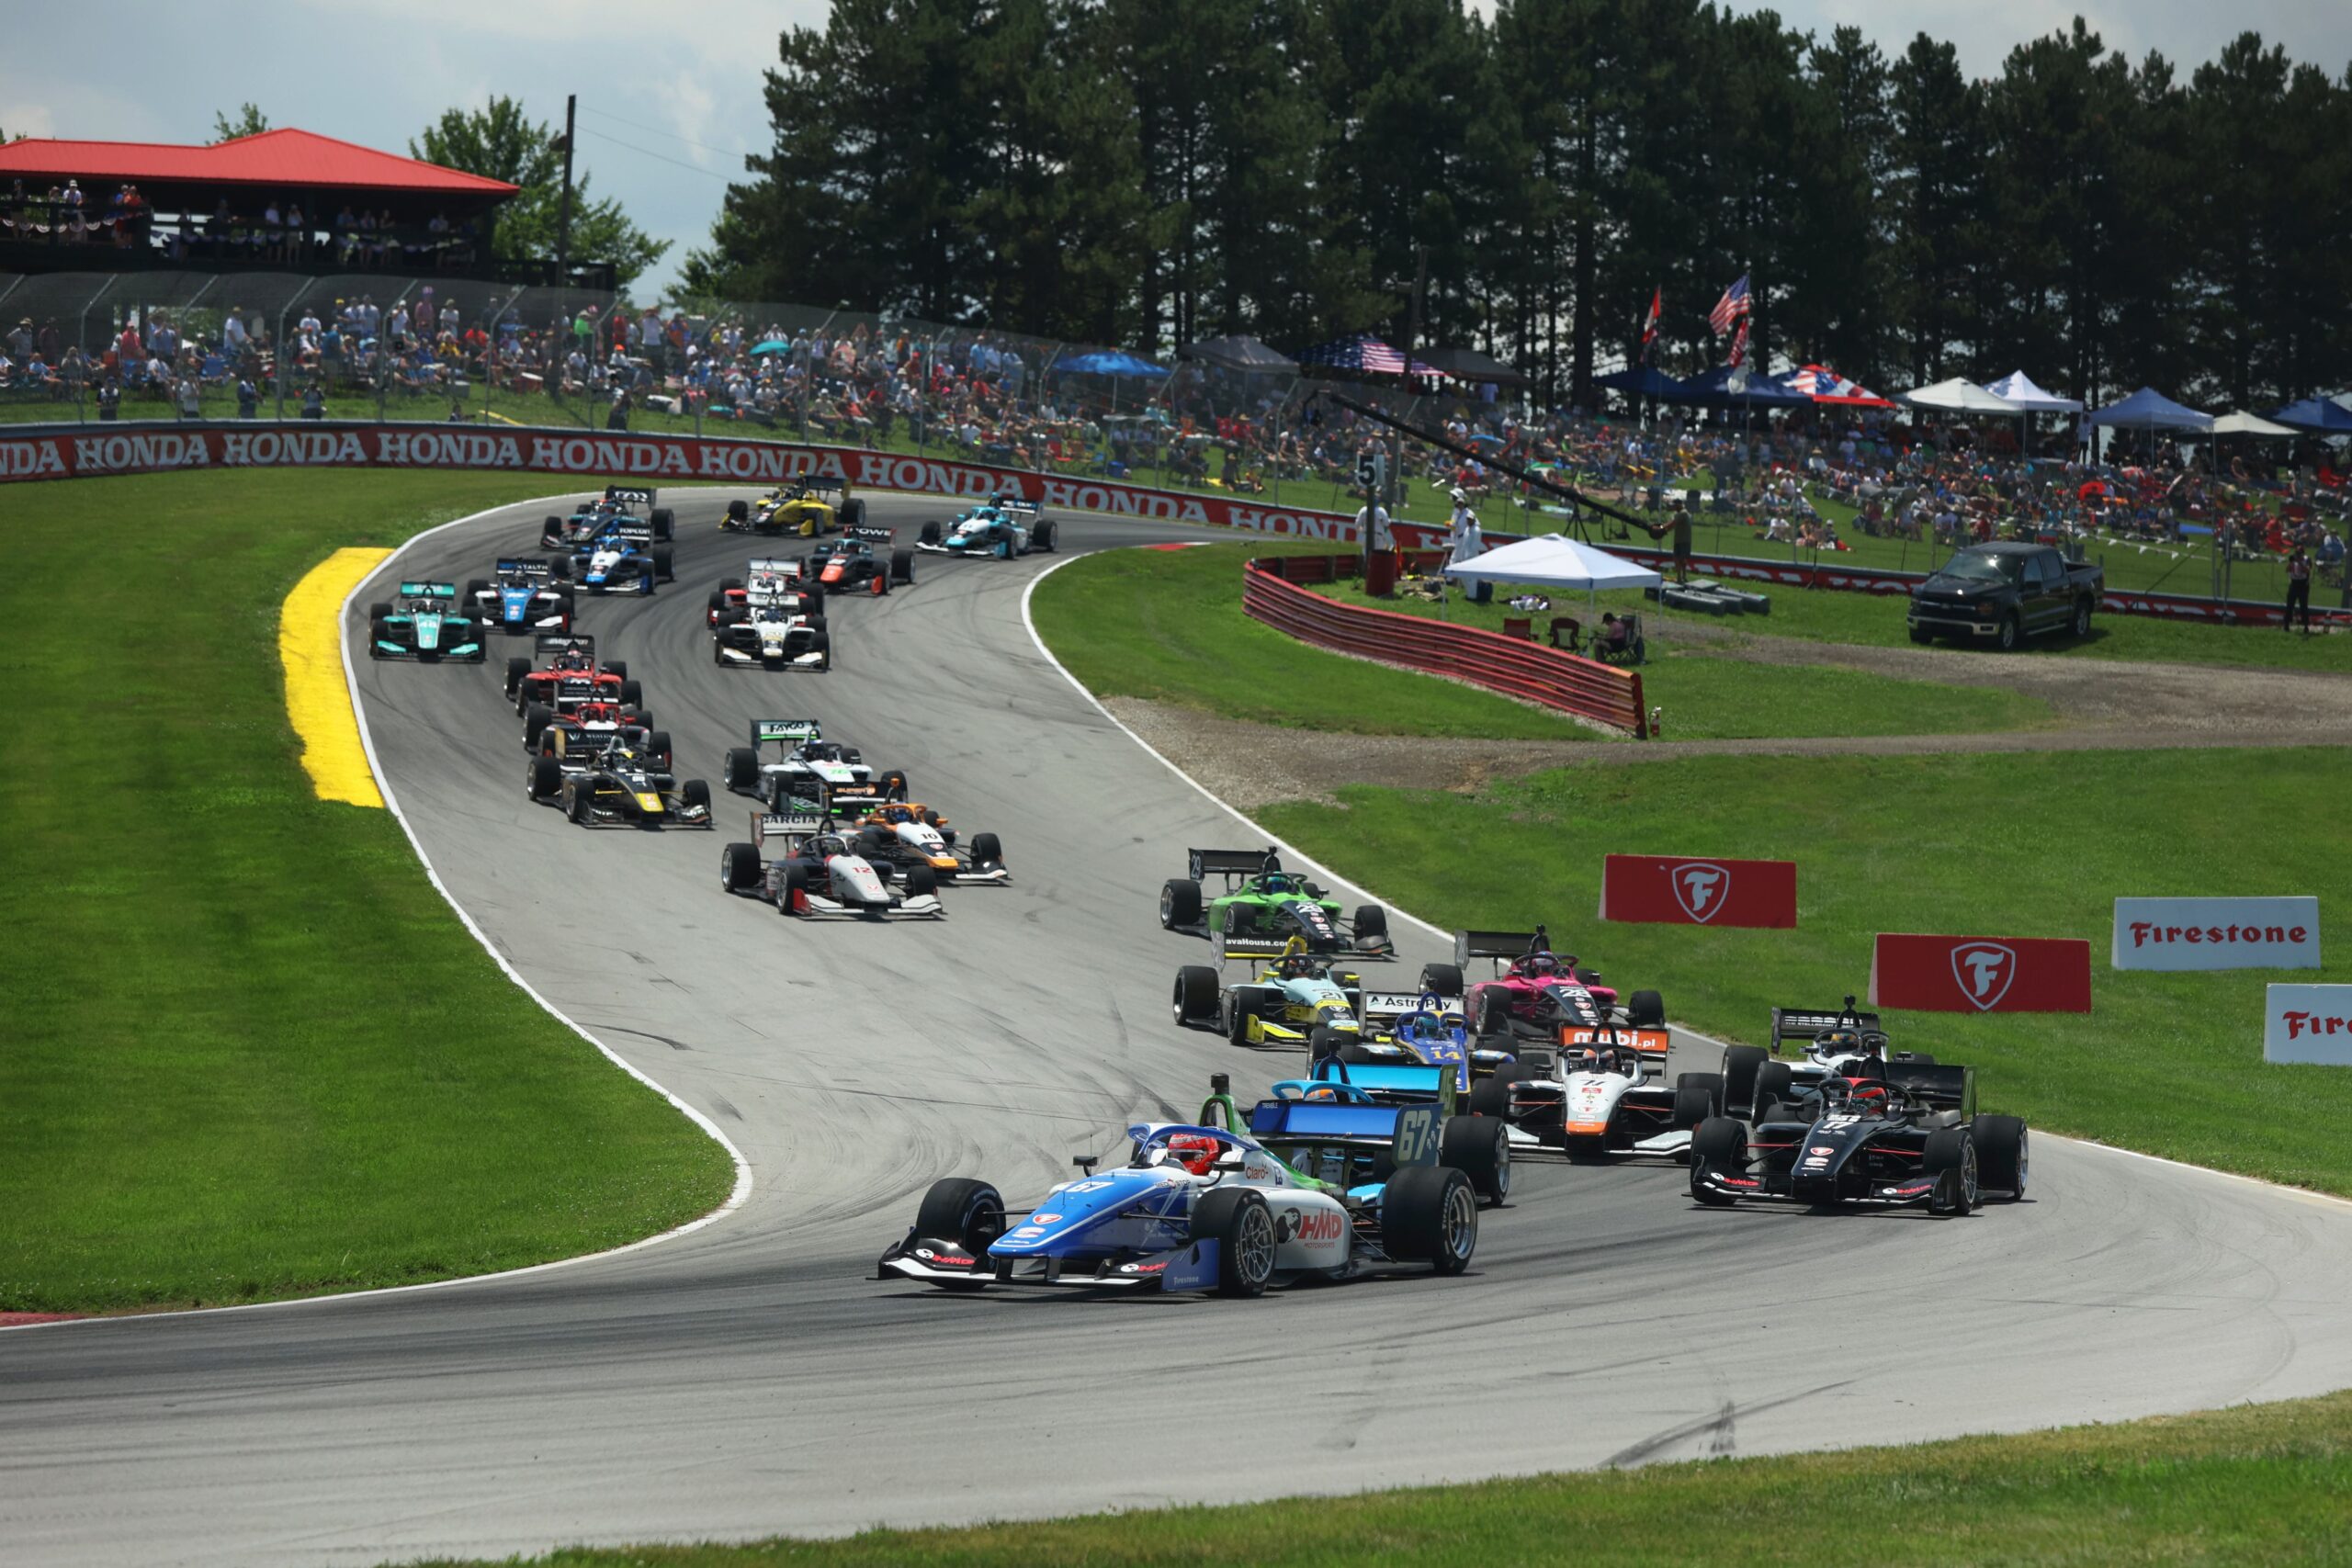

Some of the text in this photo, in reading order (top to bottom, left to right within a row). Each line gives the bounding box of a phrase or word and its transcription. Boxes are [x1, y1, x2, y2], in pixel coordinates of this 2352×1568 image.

[74, 434, 209, 470] HONDA
[222, 432, 366, 466] HONDA
[376, 432, 524, 466] HONDA
[528, 437, 693, 474] HONDA
[698, 446, 852, 479] HONDA
[855, 455, 1024, 499] HONDA
[1358, 455, 1375, 484] 5
[1042, 480, 1209, 523] HONDA
[763, 816, 817, 824] GARCIA
[2129, 921, 2308, 948] Firestone
[1385, 997, 1452, 1010] AstrPy
[1574, 1030, 1656, 1047] mubi.pl
[1431, 1050, 1461, 1060] 14
[1397, 1110, 1431, 1161] 67
[1823, 1121, 1854, 1129] 17
[1066, 1181, 1114, 1192] 67
[1246, 1167, 1265, 1179] Claro
[1297, 1208, 1343, 1240] HMD
